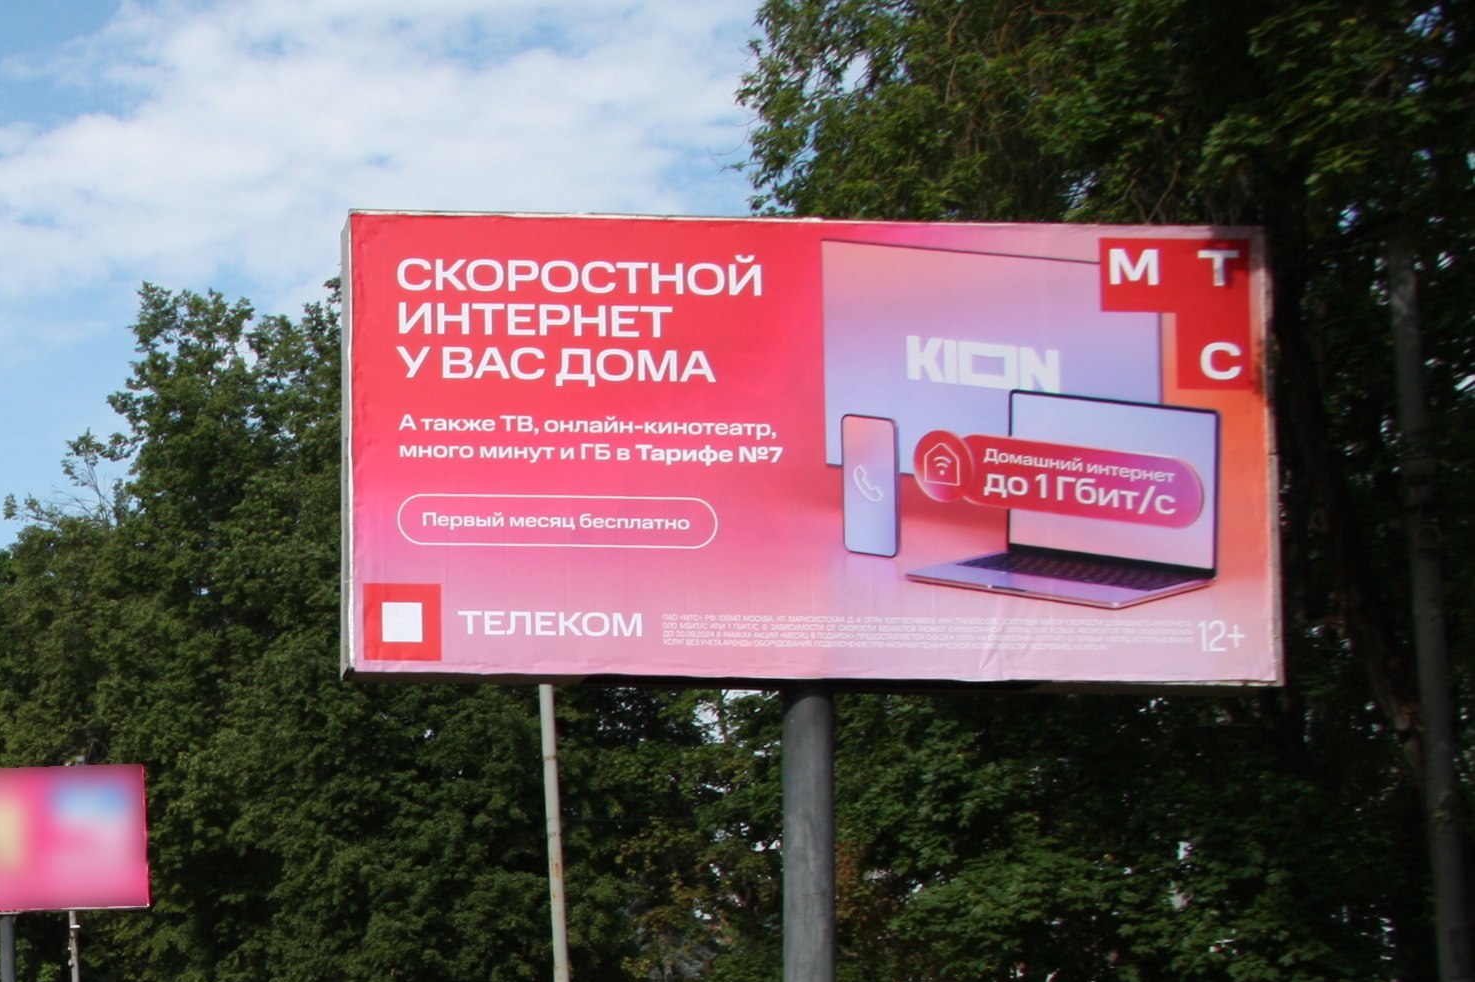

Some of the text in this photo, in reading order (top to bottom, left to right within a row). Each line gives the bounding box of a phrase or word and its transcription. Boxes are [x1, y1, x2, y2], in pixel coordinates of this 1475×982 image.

[396, 254, 763, 297] СКОРОСТНОЙ
[398, 302, 673, 338] ИНТЕРНЕТ
[396, 346, 717, 387] У ВАС ДОМА
[906, 335, 1061, 394] KION
[398, 414, 777, 440] А также ТВ, онлайн-кинотеатр,
[399, 444, 783, 467] много минут и ГБ в Тарифе №7
[983, 448, 1176, 483] Домашний интернет
[983, 473, 1177, 515] до 1 Гбит/с
[422, 511, 691, 531] Первый месяц бесплатно
[458, 610, 643, 637] ТЕЛЕКОМ
[1196, 619, 1246, 652] 12+
